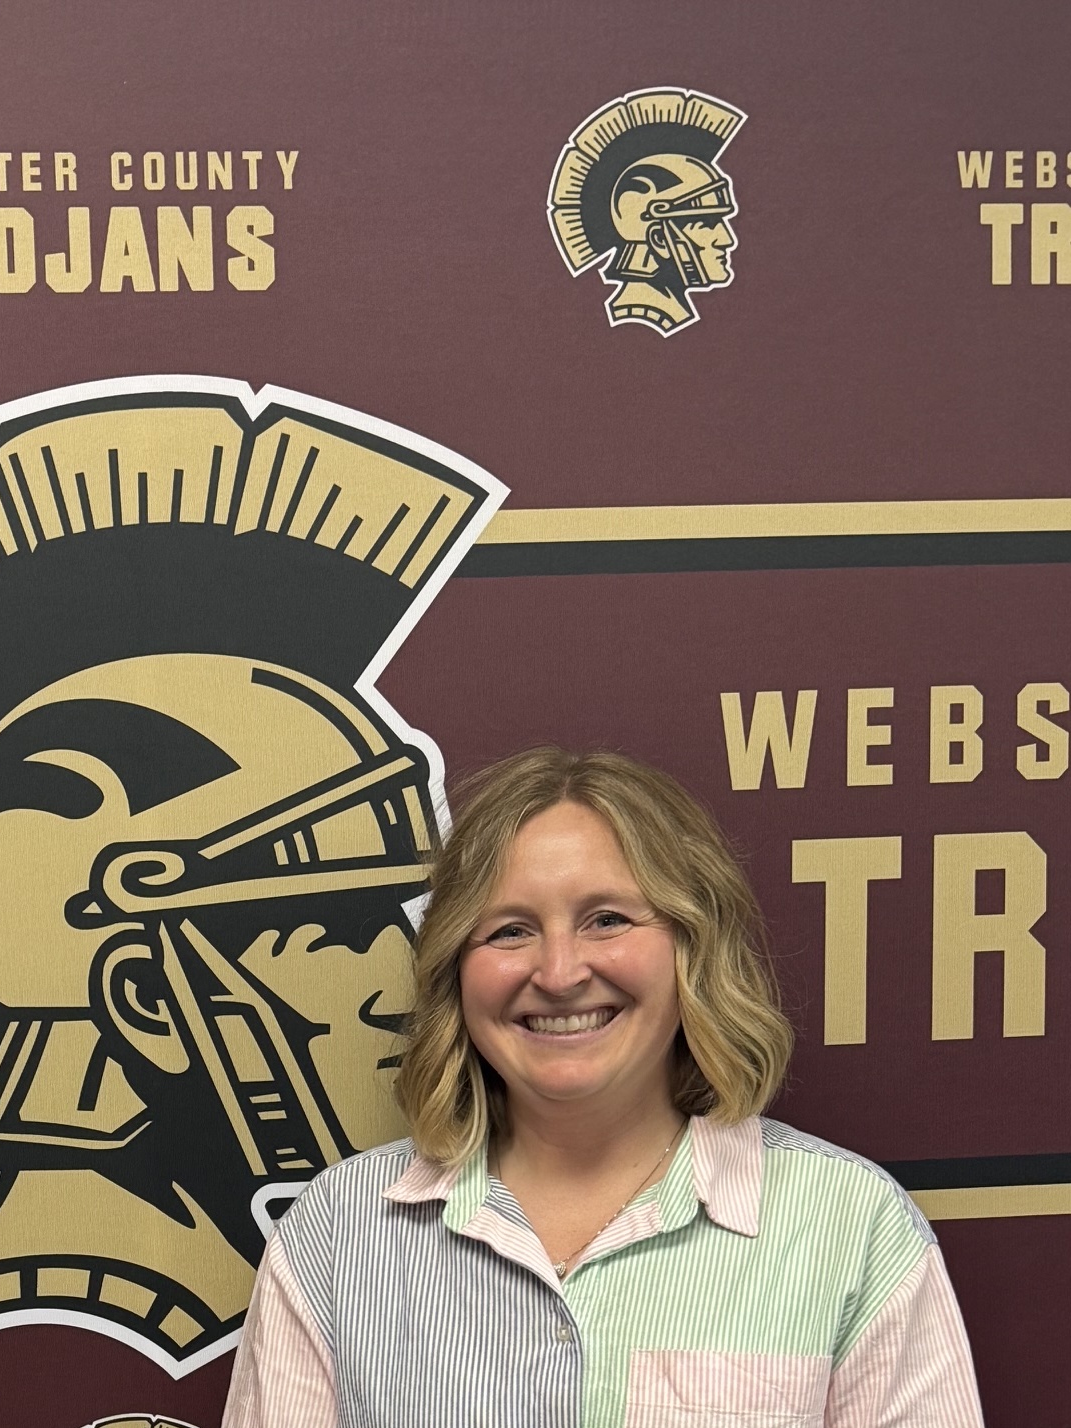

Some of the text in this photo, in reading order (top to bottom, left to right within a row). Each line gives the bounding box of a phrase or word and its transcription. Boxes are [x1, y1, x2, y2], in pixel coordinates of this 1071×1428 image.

[110, 150, 300, 191] COUNTY
[956, 150, 1071, 189] WEB
[980, 203, 1071, 286] TR
[719, 682, 1070, 791] WEBS
[791, 831, 1047, 1046] TR
